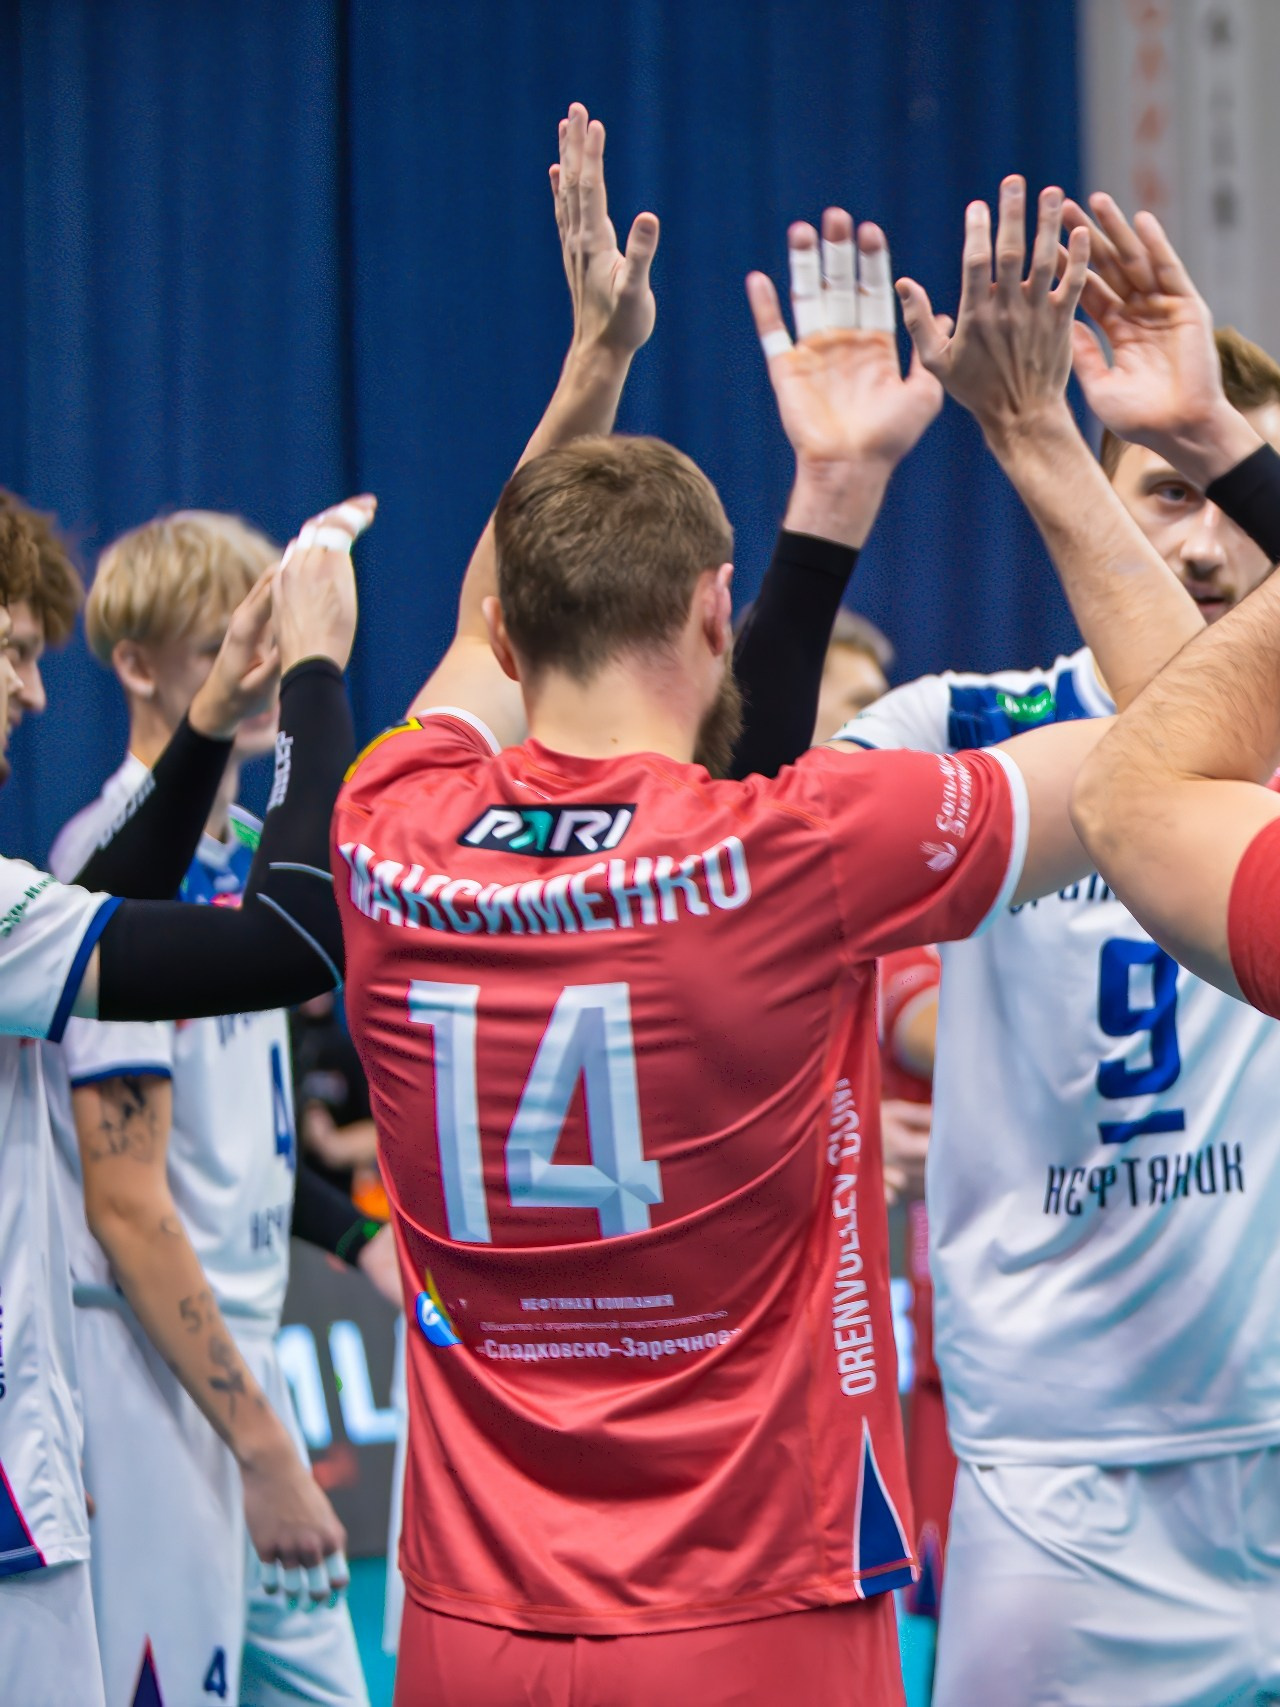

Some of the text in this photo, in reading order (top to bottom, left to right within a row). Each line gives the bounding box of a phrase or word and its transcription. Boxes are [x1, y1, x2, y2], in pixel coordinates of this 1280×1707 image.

[464, 808, 631, 853] PARI
[1097, 937, 1180, 1099] 9
[405, 979, 664, 1243] 14
[203, 1646, 227, 1699] 4
